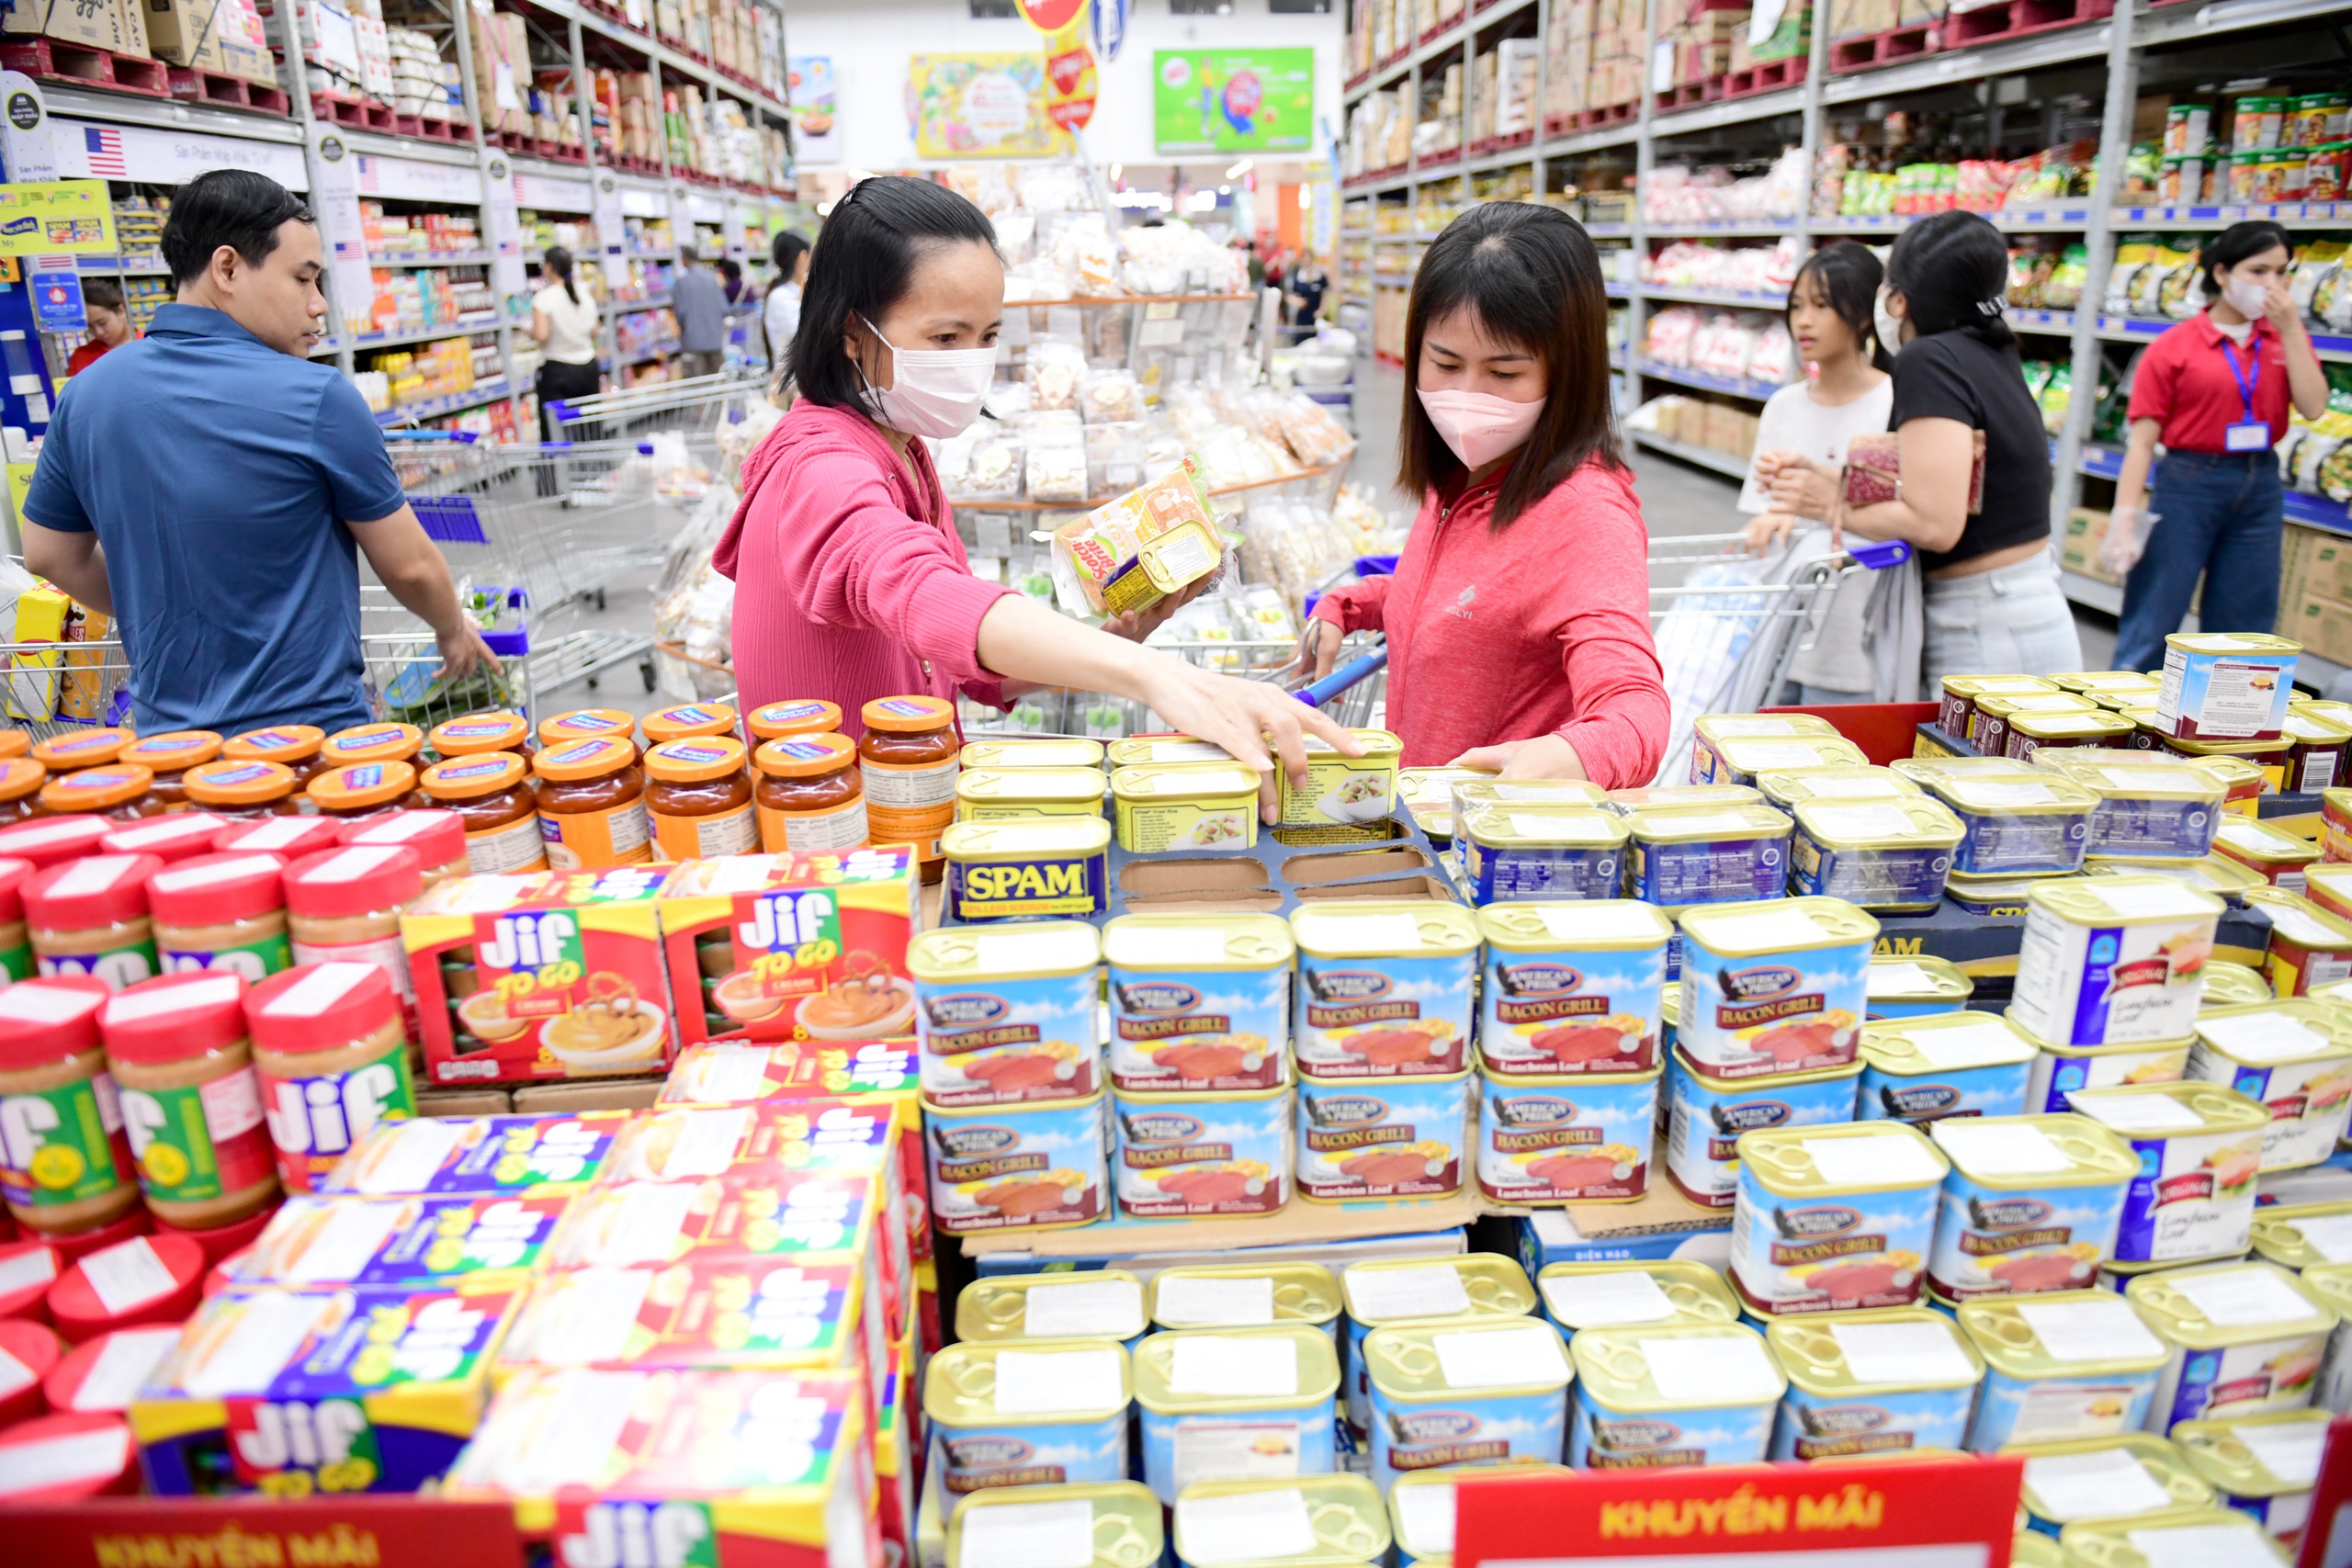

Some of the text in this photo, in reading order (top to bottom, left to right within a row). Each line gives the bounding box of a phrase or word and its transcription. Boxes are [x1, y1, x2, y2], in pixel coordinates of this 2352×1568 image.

[1084, 539, 1116, 570] Brite
[843, 849, 898, 883] Jif
[596, 867, 654, 899] Jif
[967, 863, 1084, 900] SPAM
[739, 894, 833, 948] Jif
[480, 912, 576, 969] Jif
[1871, 937, 1923, 955] AM
[751, 939, 838, 984] TO GO
[493, 960, 582, 1003] TO GO
[771, 976, 816, 991] CREAMY
[1508, 970, 1572, 985] AMERICAN
[1731, 971, 1792, 991] AMERICAN
[2117, 967, 2167, 987] ORIGINAL
[1311, 1003, 1411, 1025] BACON GRILL
[1500, 998, 1601, 1020] BACON GRILL
[1721, 996, 1821, 1024] BACON GRILL
[793, 1024, 809, 1042] 8
[1121, 1017, 1222, 1037] BACON GRILL
[930, 1026, 1031, 1052] BACON GRILL
[538, 1046, 554, 1062] 8
[851, 1044, 908, 1090] Jif
[1311, 1064, 1396, 1076] Luncheon Loaf
[1499, 1060, 1586, 1074] Luncheon Loaf
[1719, 1059, 1801, 1078] Luncheon Loaf
[1124, 1077, 1209, 1089] Luncheon Loaf
[935, 1089, 1023, 1104] Luncheon Loaf
[266, 1064, 398, 1152] Jif
[1317, 1102, 1378, 1117] AMERICAN
[1504, 1103, 1566, 1117] AMERICAN
[1723, 1105, 1782, 1122] AMERICAN
[1310, 1127, 1407, 1147] BACON GRILL
[1497, 1129, 1596, 1148] BACON GRILL
[1126, 1145, 1223, 1166] BACON GRILL
[941, 1155, 1040, 1179] BACON GRILL
[1311, 1184, 1394, 1197] Luncheon Loaf
[1497, 1186, 1580, 1199] Luncheon Loaf
[2161, 1179, 2213, 1201] ORIGINAL
[1130, 1201, 1214, 1214] Luncheon Loaf
[946, 1213, 1031, 1229] Luncheon Loaf
[1775, 1237, 1879, 1262] BACON GRILL
[233, 1400, 367, 1470] Jif
[1393, 1443, 1501, 1469] BACON GRILL
[946, 1467, 1056, 1492] BACON GRILL
[1600, 1482, 1885, 1539] KHUYẾN MÃI
[561, 1501, 709, 1568] Jif
